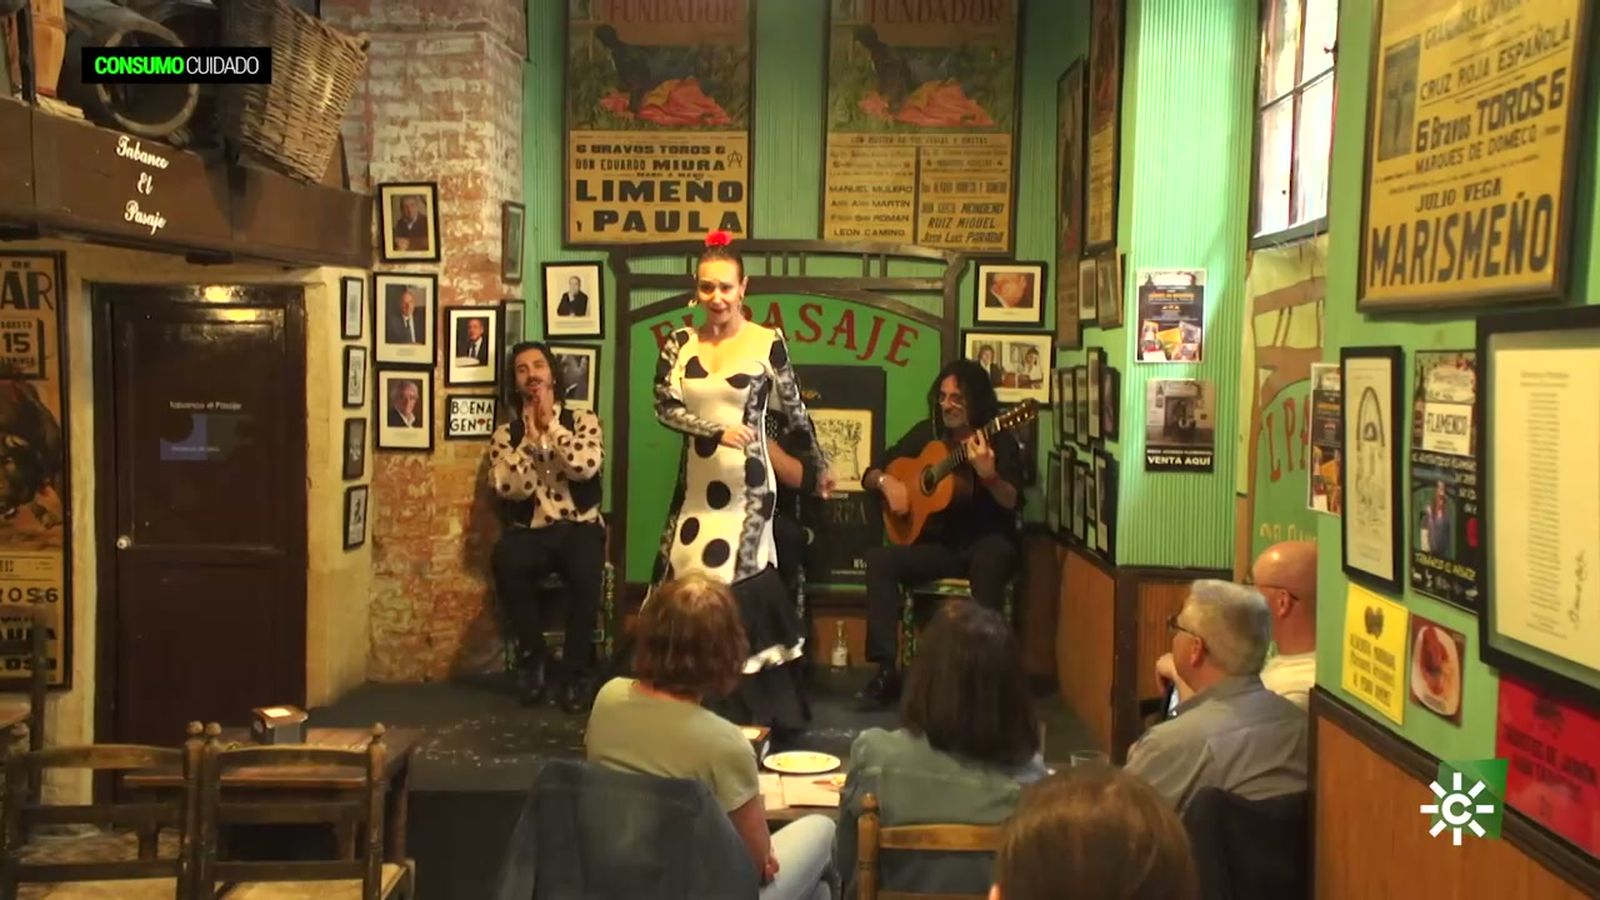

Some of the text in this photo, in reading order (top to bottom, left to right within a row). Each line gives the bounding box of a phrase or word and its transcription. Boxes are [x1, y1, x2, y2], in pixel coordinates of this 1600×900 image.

[1420, 73, 1452, 102] CRUZ
[1459, 58, 1490, 88] ROJA
[1499, 18, 1570, 72] ESPAÑOLA
[1416, 67, 1567, 153] 6 Bravos TOROS 6
[576, 144, 726, 155] 6 BRAVOS TOROS 6
[1469, 140, 1483, 162] DE
[576, 158, 726, 171] DON EDUARDO MIURA
[137, 171, 153, 195] El
[1415, 178, 1502, 213] JULIO VEGA
[124, 200, 167, 236] Pasaje
[593, 210, 743, 233] PAULA
[928, 216, 997, 229] RUIZ MIGUEL
[1369, 191, 1554, 288] MARISMEÑO
[2, 333, 31, 353] 15
[1426, 412, 1468, 436] FLAMENCO
[1147, 456, 1211, 466] VENTA AQUÍ
[0, 587, 59, 603] OS 6
